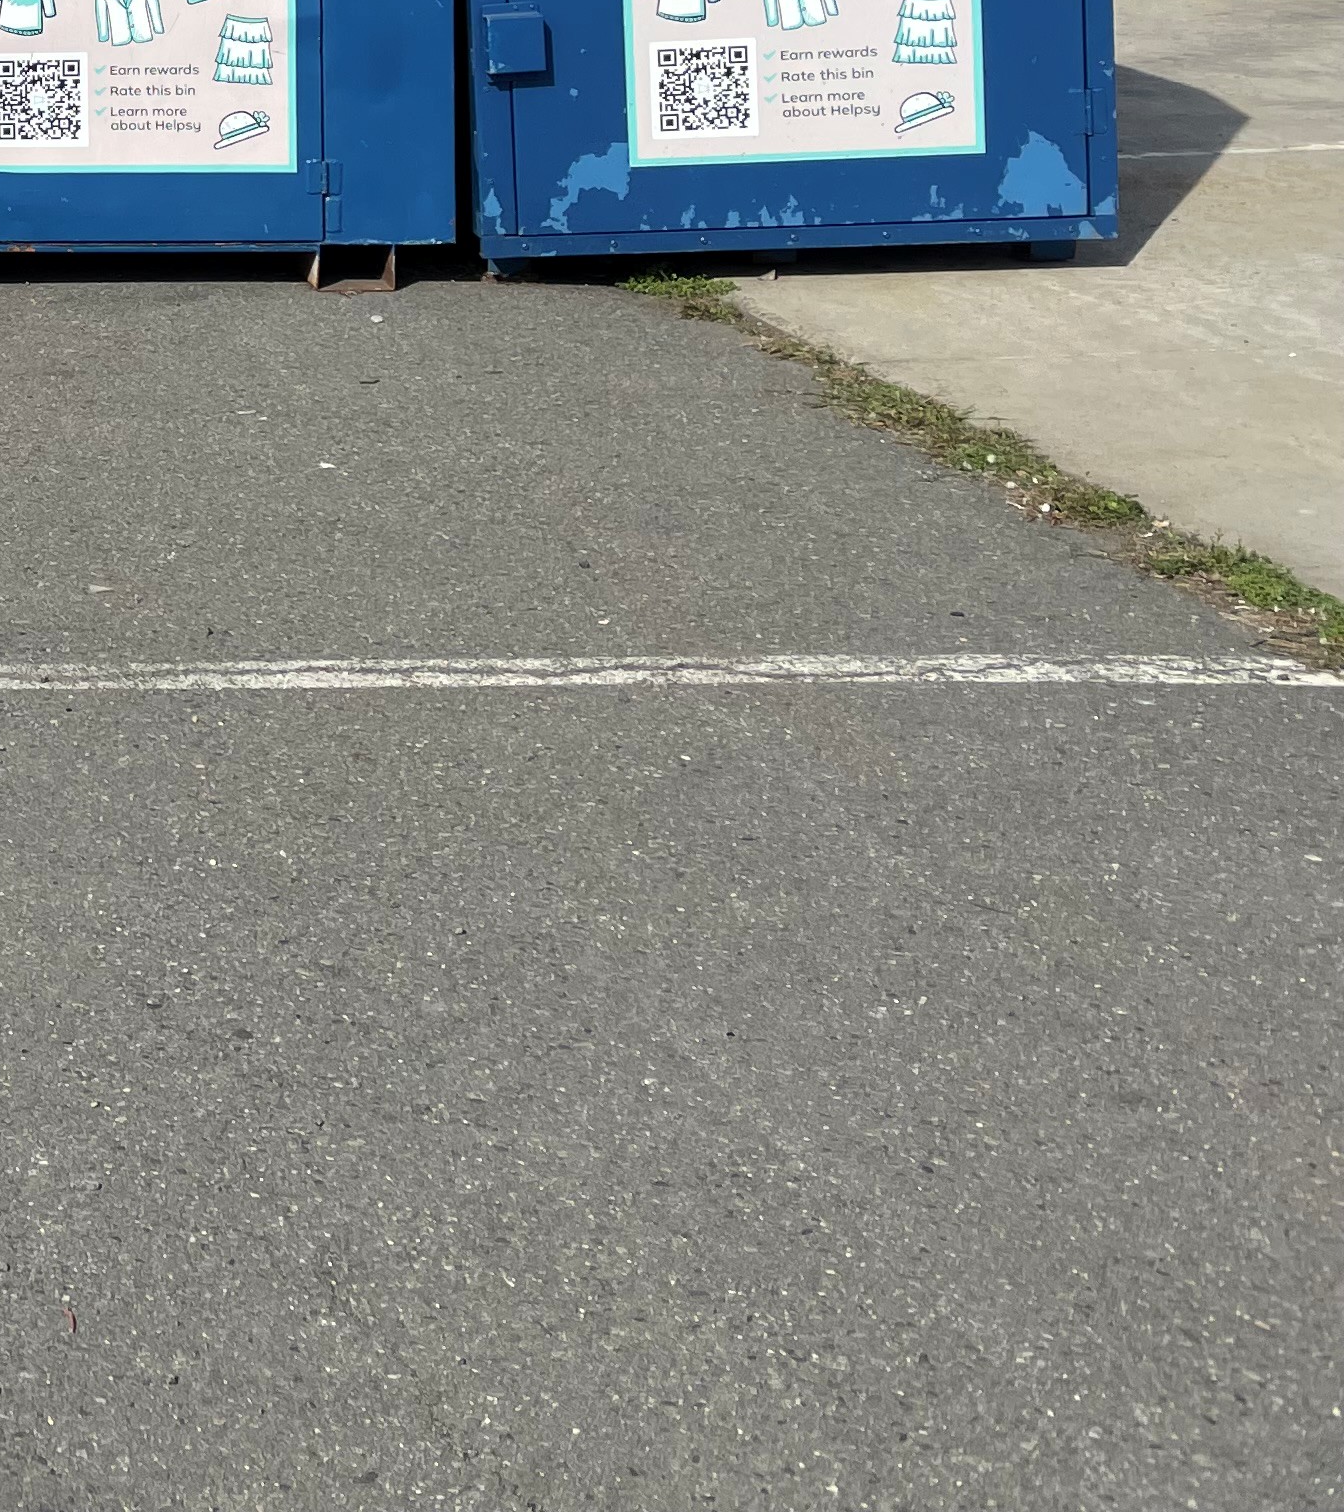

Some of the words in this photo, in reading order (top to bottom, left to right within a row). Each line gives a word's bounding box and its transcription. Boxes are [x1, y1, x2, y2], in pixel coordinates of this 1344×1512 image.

[780, 50, 814, 61] Earn
[818, 46, 878, 60] rewards
[110, 65, 141, 76] Earn
[144, 64, 199, 76] rewards
[781, 71, 816, 82] Rate
[820, 69, 847, 81] this
[852, 68, 874, 80] bin
[110, 85, 142, 96] Rate
[146, 85, 171, 96] this
[175, 85, 196, 96] bin
[782, 93, 824, 104] Learn
[828, 91, 866, 102] more
[110, 106, 149, 117] Learn
[152, 107, 187, 117] more
[783, 106, 828, 118] about
[831, 104, 881, 118] Helpsy
[110, 120, 152, 131] about
[155, 120, 201, 133] Helpsy
